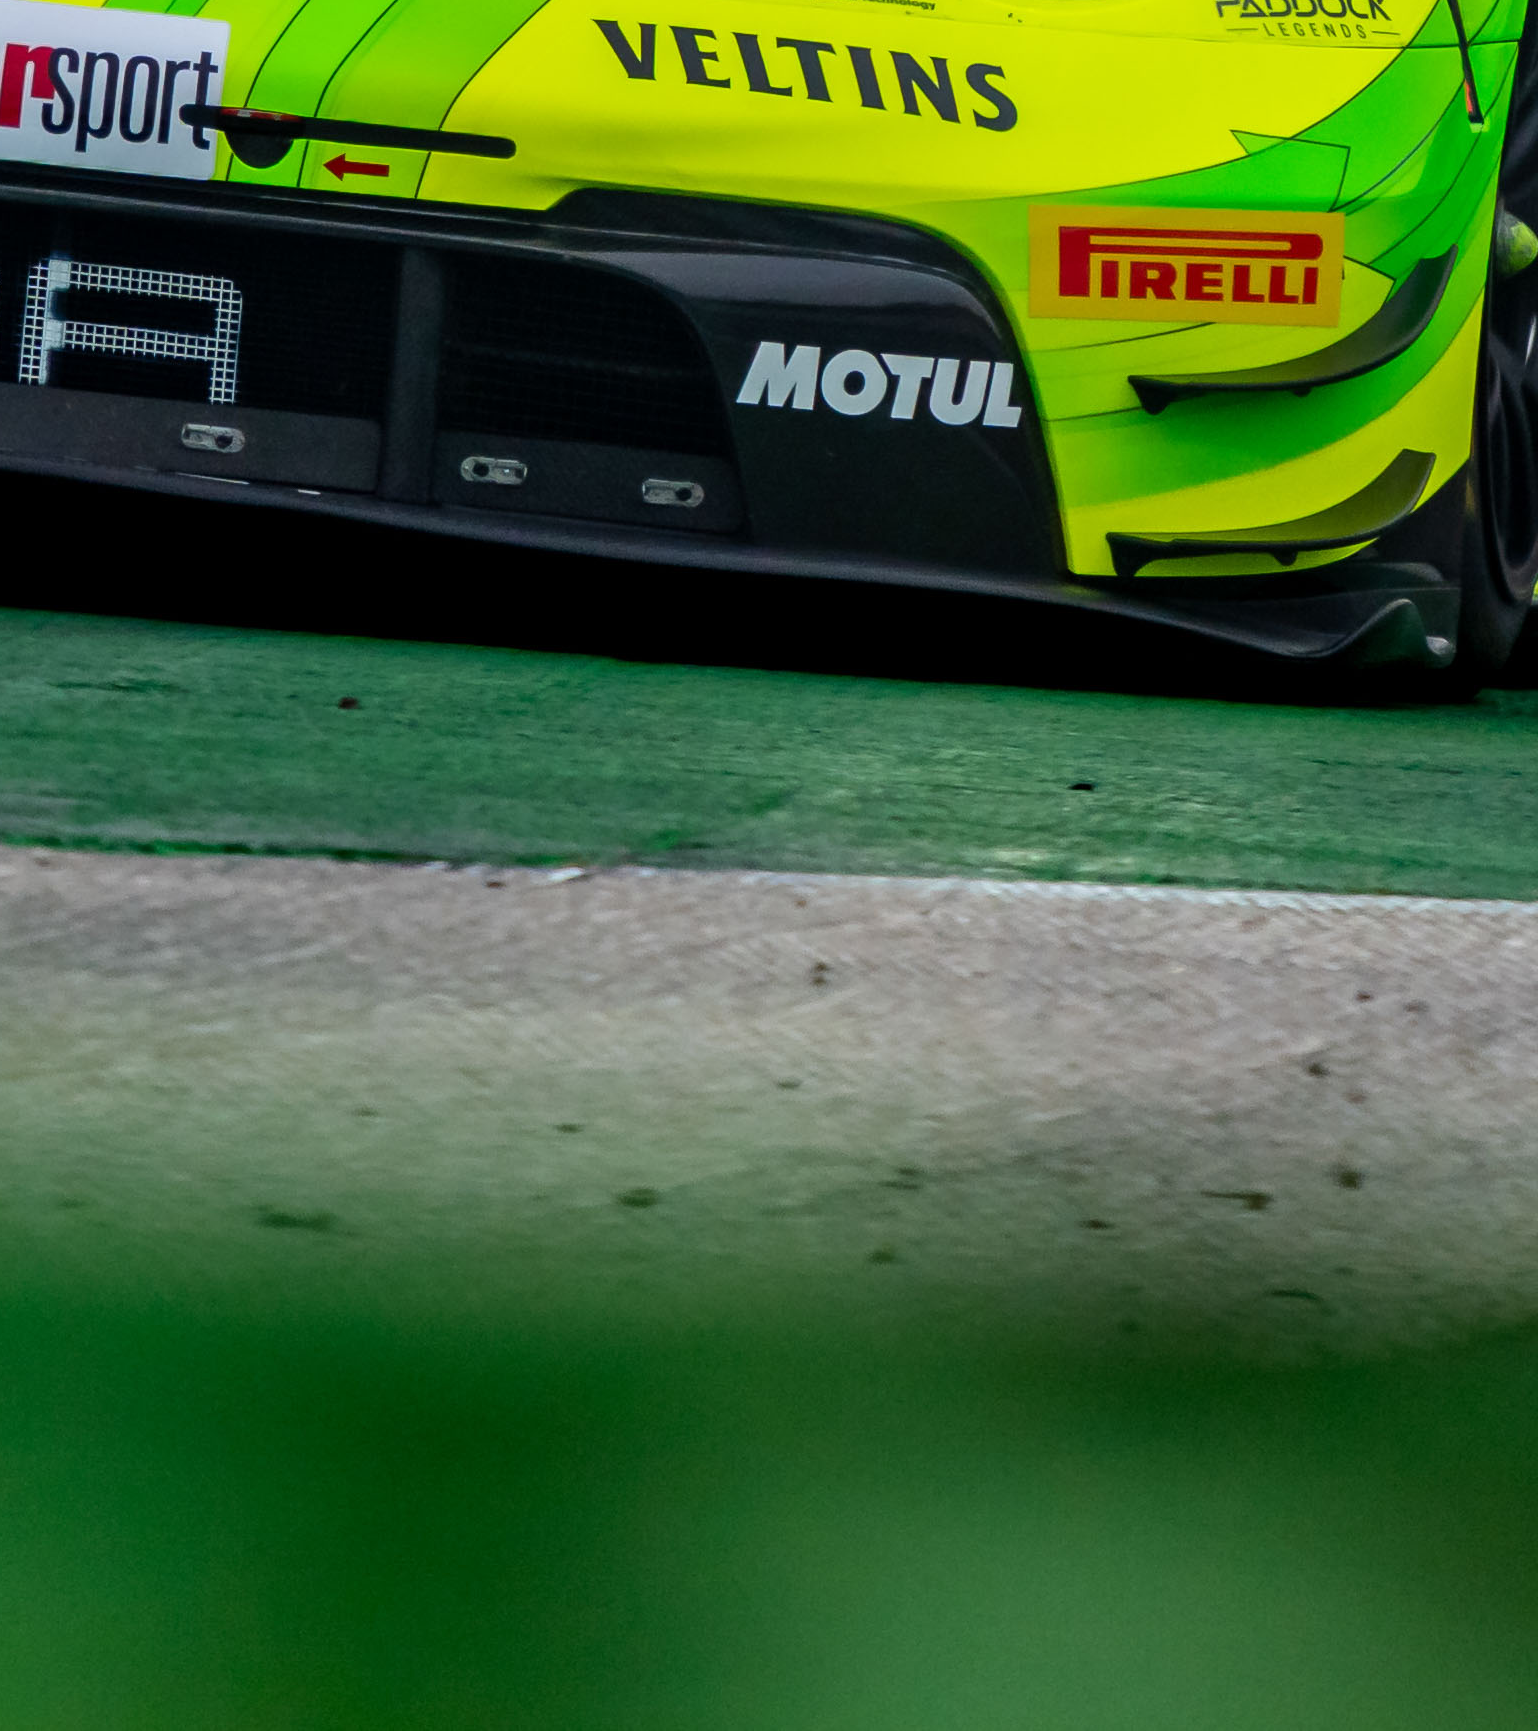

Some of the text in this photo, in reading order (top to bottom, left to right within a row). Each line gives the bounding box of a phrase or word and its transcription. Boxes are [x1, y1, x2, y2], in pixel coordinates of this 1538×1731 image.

[1262, 22, 1369, 40] LEGENDS
[591, 18, 1019, 133] VELTINS
[1056, 225, 1324, 306] PIRELLI
[735, 340, 1022, 429] MOTUL
